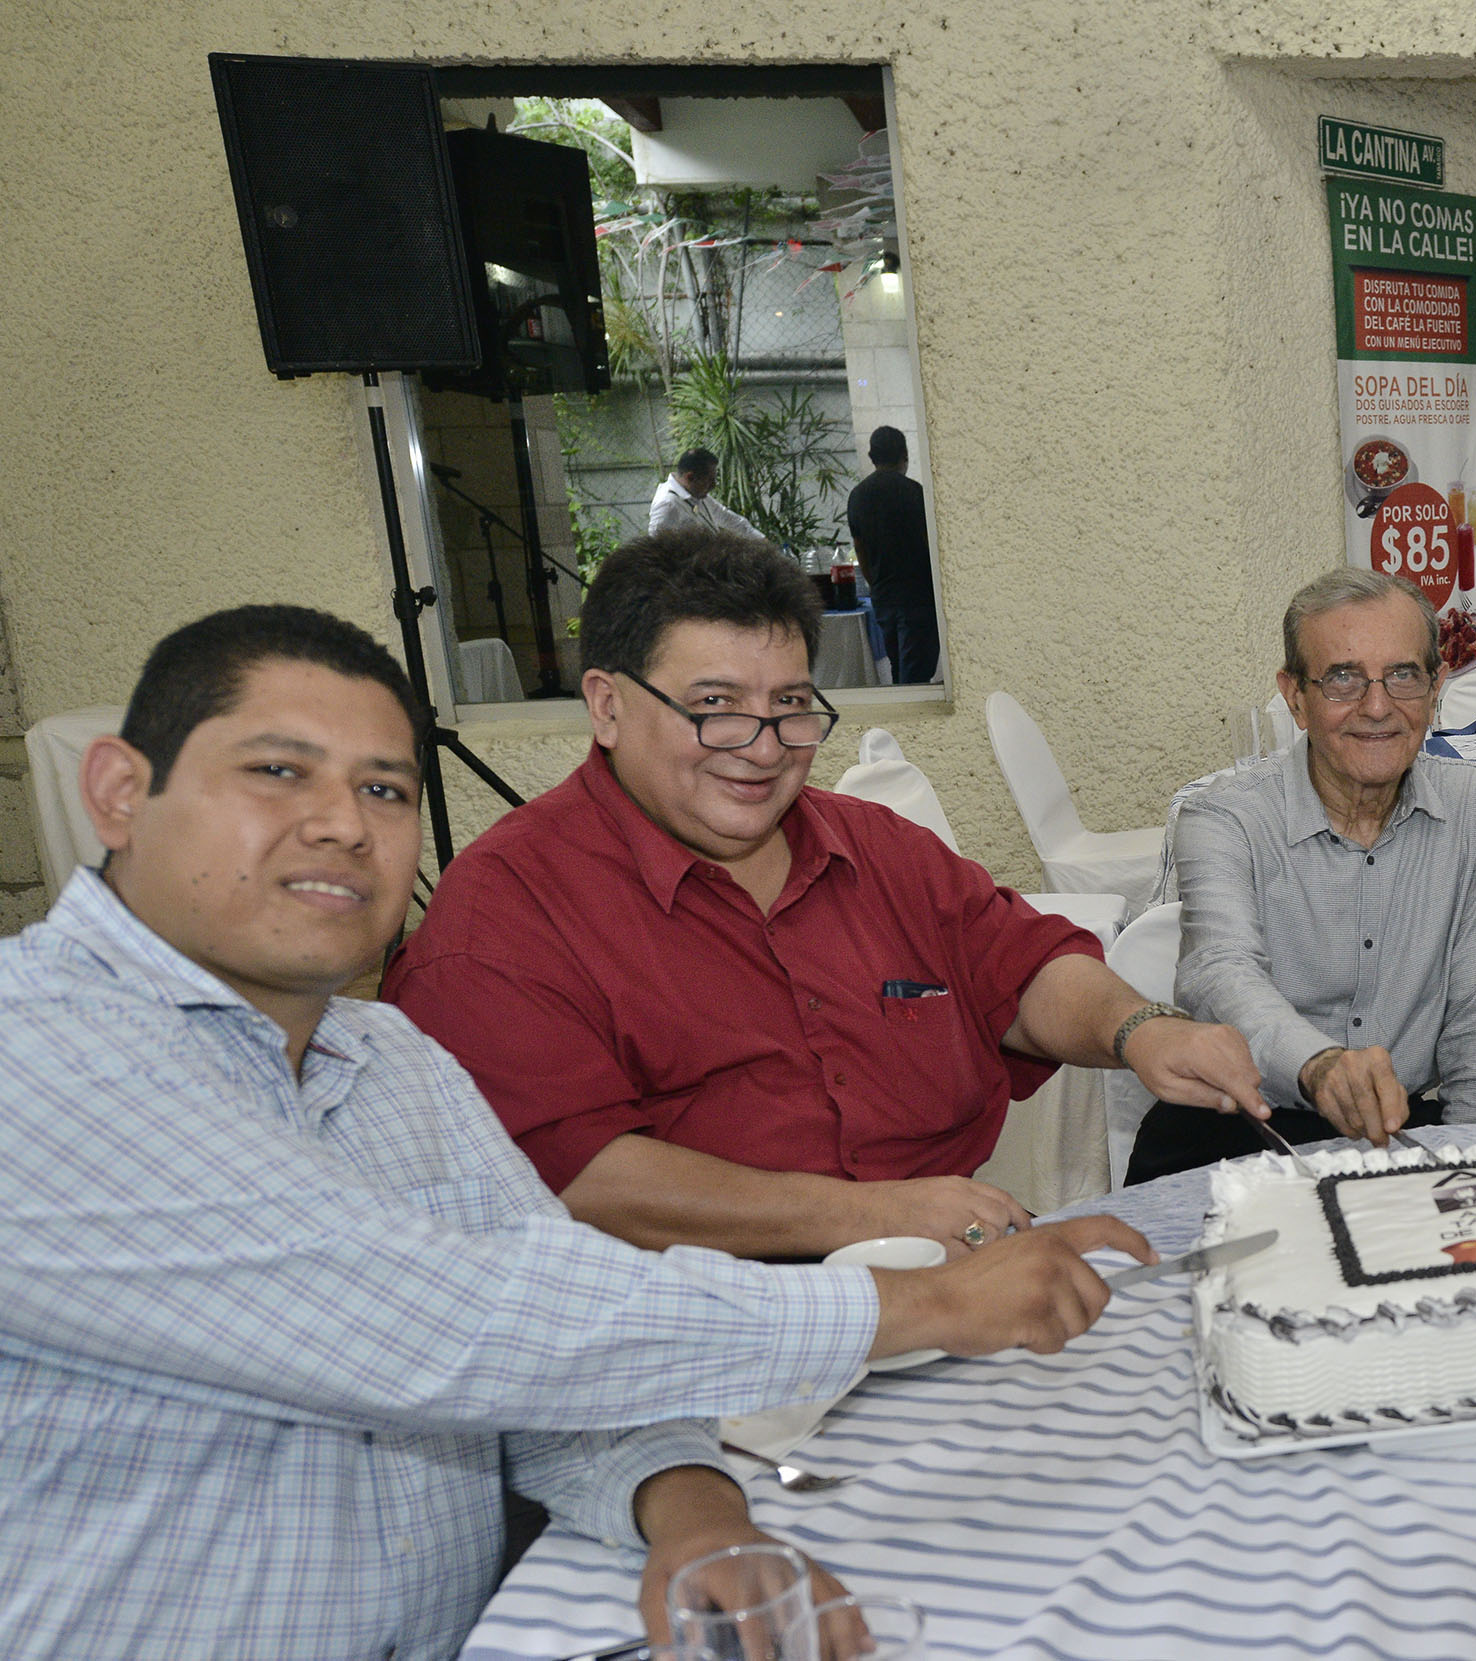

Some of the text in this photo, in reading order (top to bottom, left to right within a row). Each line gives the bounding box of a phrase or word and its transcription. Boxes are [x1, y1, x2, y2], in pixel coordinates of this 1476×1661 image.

[1326, 125, 1436, 174] LA CANTINA AV.
[1340, 192, 1474, 234] ¡YA NO COMAS
[1344, 224, 1473, 262] EN LA CALLE!
[1364, 279, 1460, 299] DISFRUTA TU COMIDA
[1364, 296, 1460, 317] CON LA COMODIDAD
[1364, 315, 1461, 334] DEL CAFÉ LA FUENTE
[1365, 335, 1462, 351] CON UN MENÚ EJECUTIVO
[1355, 372, 1468, 397] SOPA DEL DÍA
[1356, 399, 1469, 411] DOS GUISADOS A ESCOGER
[1393, 415, 1416, 424] AGUA
[1419, 415, 1447, 424] FRESCA
[1449, 415, 1454, 424] O
[1383, 503, 1448, 523] POR SOLO
[1381, 524, 1450, 576] $85
[1420, 574, 1450, 586] IVA inc.
[1440, 1229, 1474, 1240] DE
